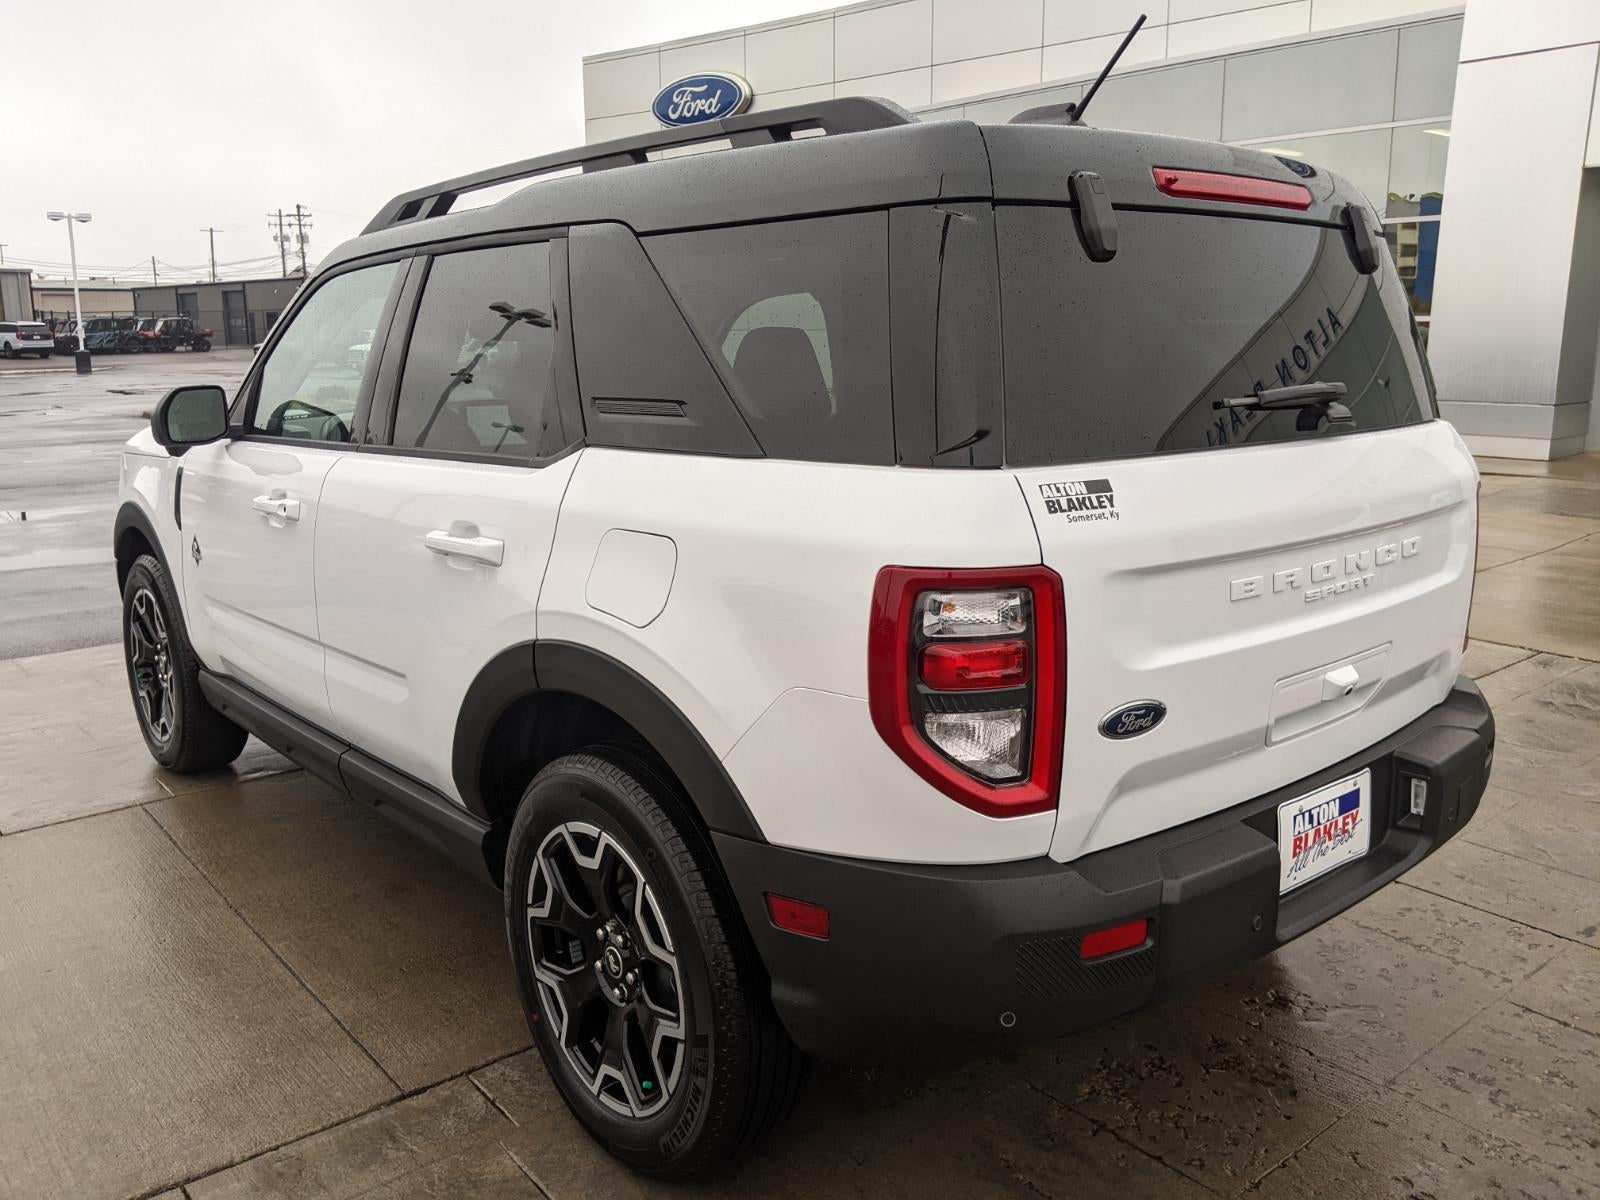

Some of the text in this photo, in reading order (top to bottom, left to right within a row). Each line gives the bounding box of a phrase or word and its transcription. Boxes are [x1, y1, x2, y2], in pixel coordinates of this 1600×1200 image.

[668, 84, 722, 120] Ford
[1040, 481, 1088, 499] ALTON
[1045, 494, 1114, 514] BLAKLEY
[1066, 510, 1120, 523] Somerset, Ky
[1230, 536, 1421, 601] BRONCO
[1304, 573, 1376, 602] SPORT
[1117, 709, 1155, 733] Ford
[1294, 798, 1340, 836] ALTON
[1292, 810, 1359, 859] BLAKLEY
[662, 1081, 702, 1155] MICHELIN
